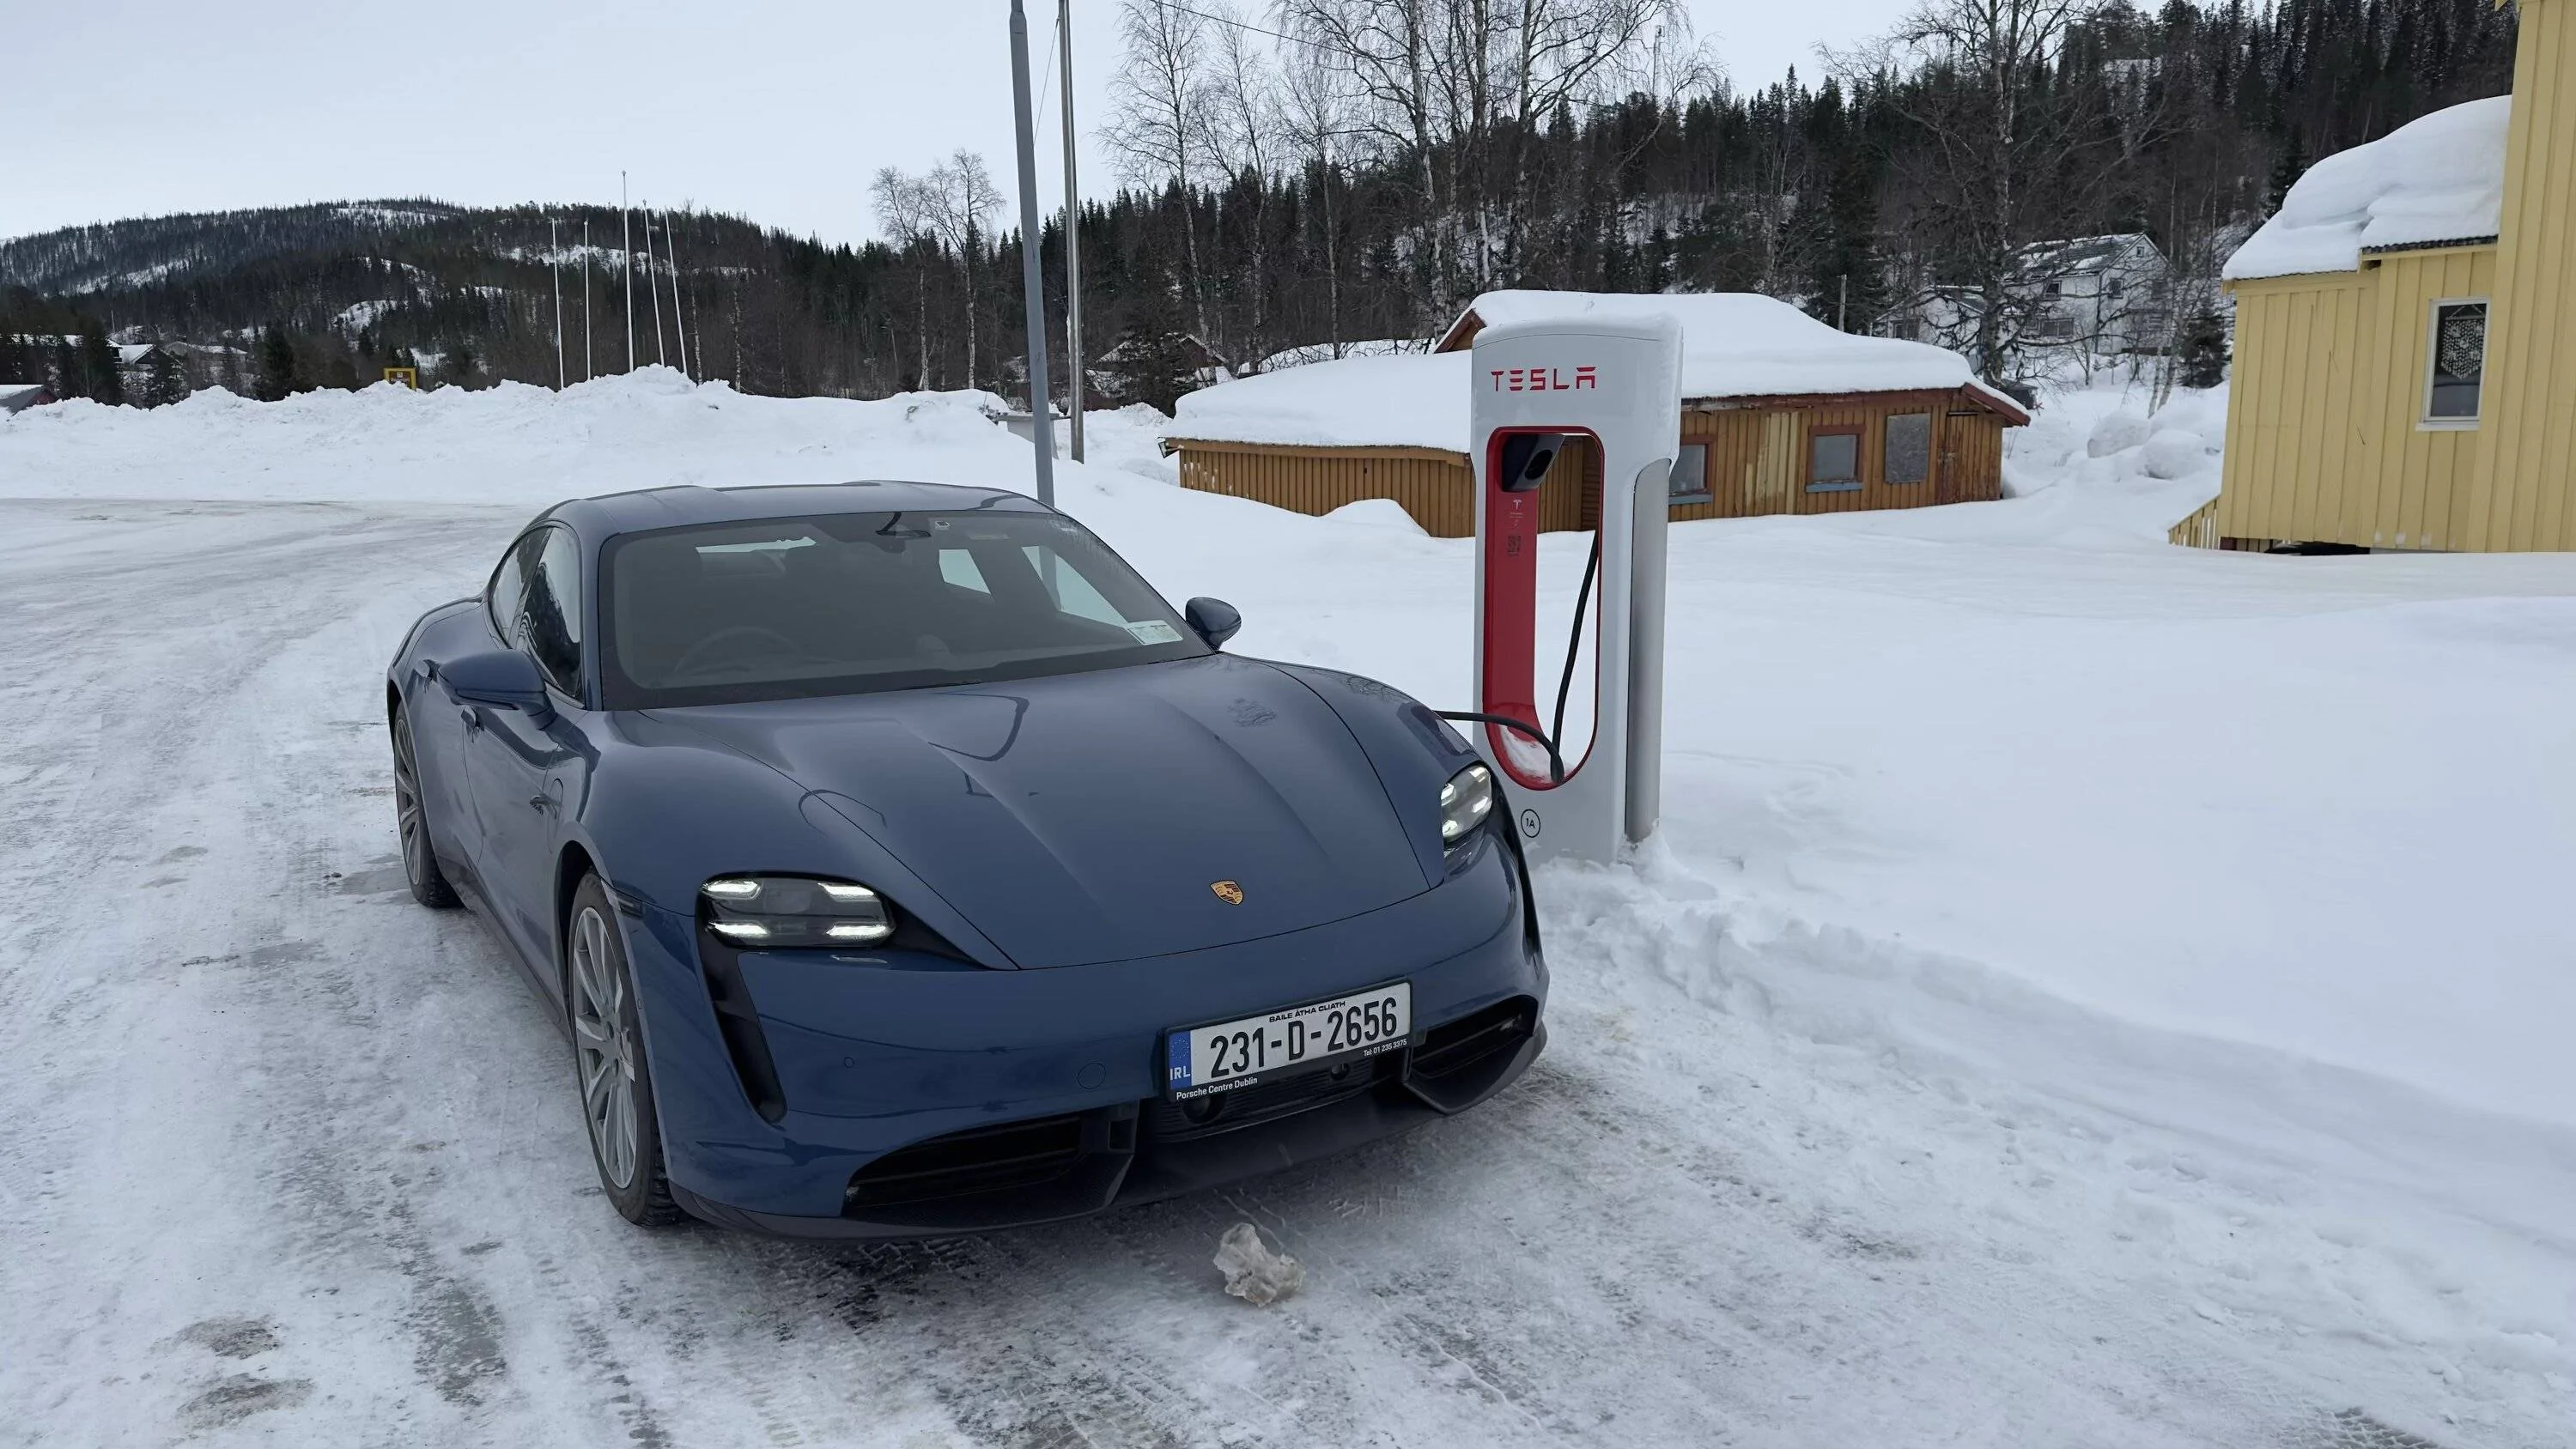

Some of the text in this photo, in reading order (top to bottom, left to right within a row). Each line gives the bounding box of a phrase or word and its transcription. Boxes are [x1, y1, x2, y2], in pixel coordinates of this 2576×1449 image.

[1491, 366, 1596, 391] TESLA
[1526, 817, 1535, 828] 1A
[1269, 1001, 1346, 1022] BAILE ÁTHA CLIATH
[1210, 997, 1397, 1078] 231-D-2656
[1381, 1043, 1392, 1052] 235
[1393, 1038, 1407, 1048] 3375
[1170, 1066, 1191, 1081] IRL
[1176, 1076, 1258, 1100] Porsche Centre Dublin
